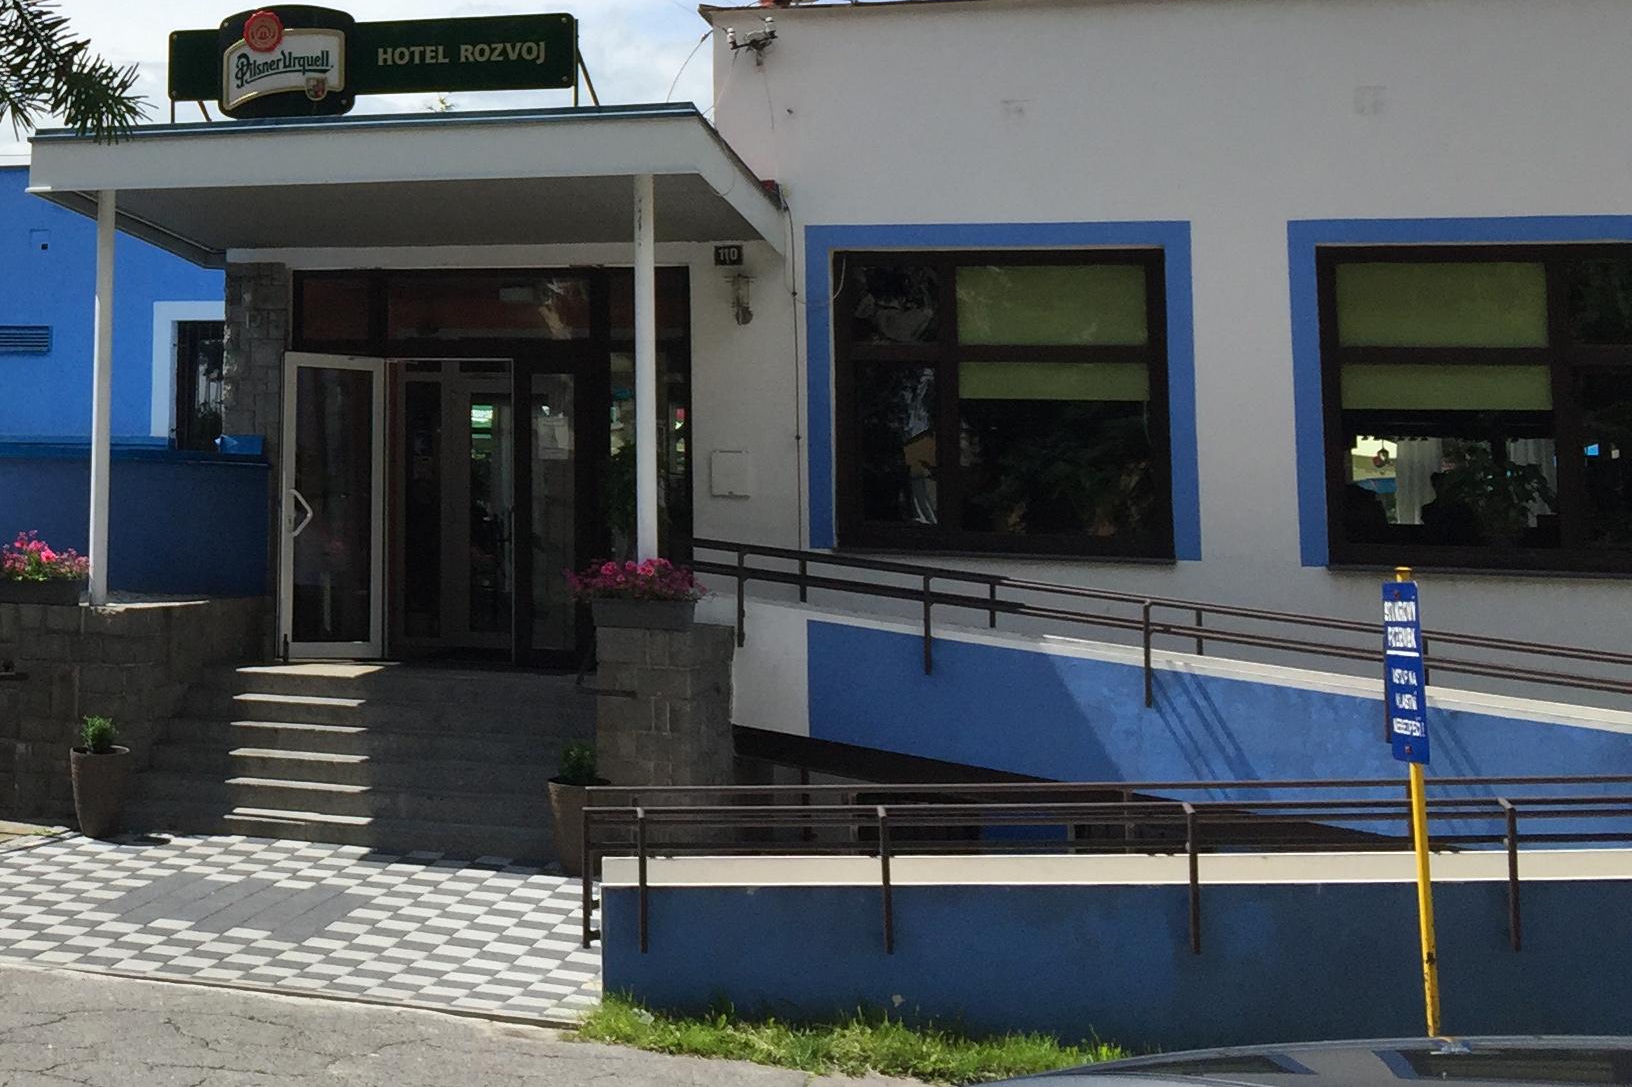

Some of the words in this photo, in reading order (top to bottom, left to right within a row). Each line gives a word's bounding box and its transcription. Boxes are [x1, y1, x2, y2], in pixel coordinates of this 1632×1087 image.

[377, 46, 450, 66] HOTEL
[459, 41, 546, 64] ROZVOJ
[234, 52, 283, 89] Pilsner
[718, 247, 738, 261] 110
